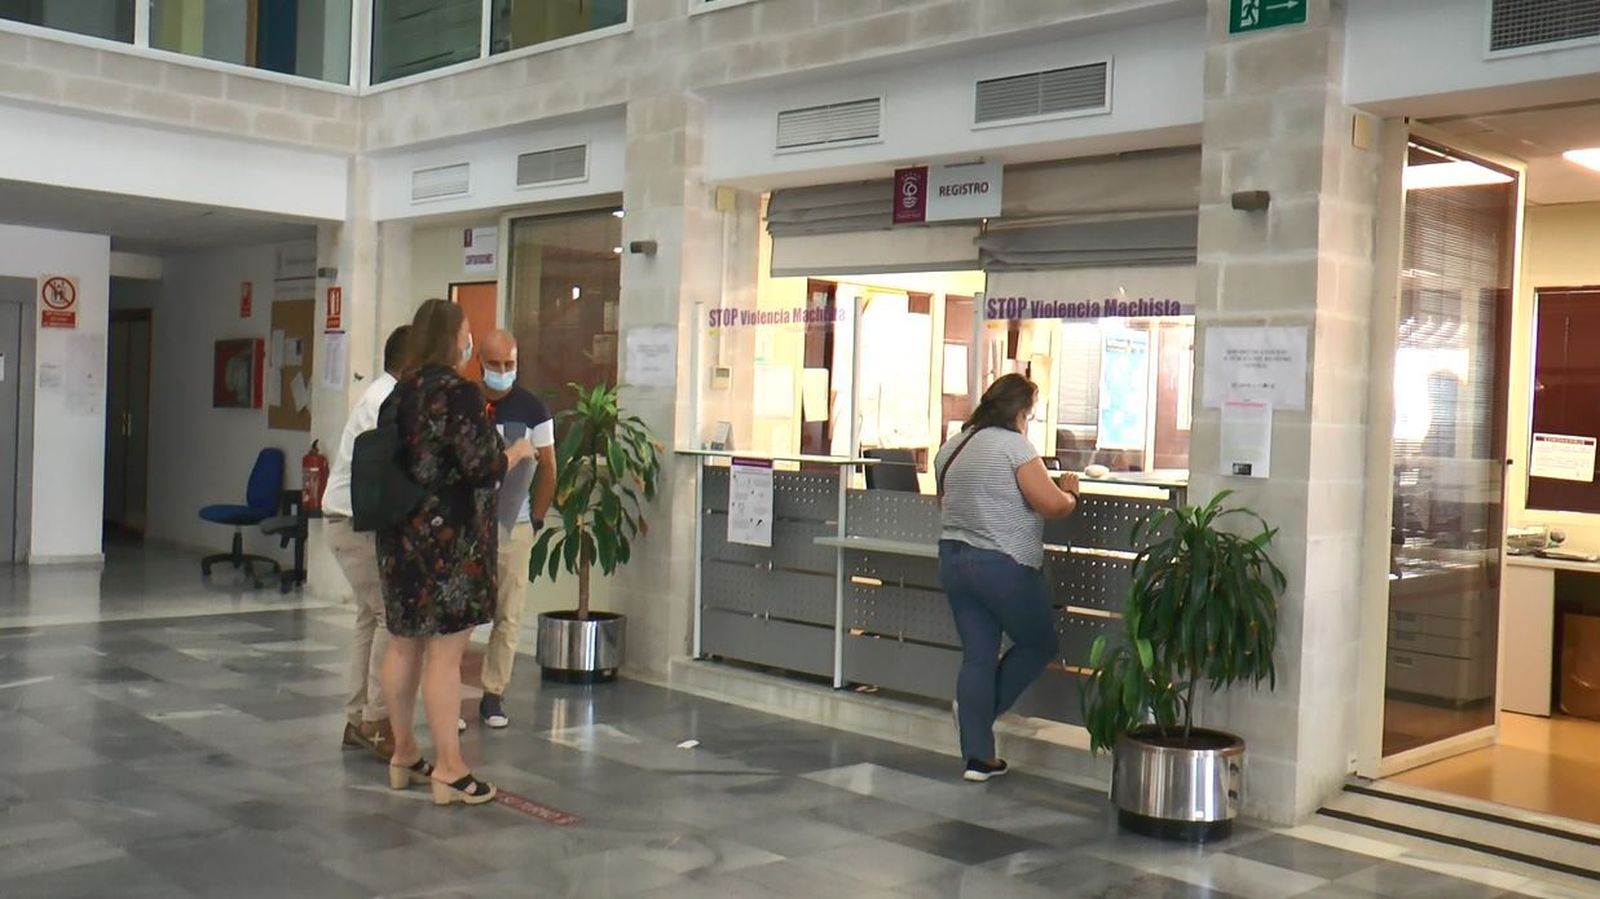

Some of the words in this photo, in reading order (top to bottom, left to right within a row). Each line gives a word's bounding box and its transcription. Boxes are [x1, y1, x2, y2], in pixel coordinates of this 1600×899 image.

[939, 181, 989, 197] REGISTRO
[709, 308, 738, 327] STOP
[741, 308, 789, 325] Violencia
[987, 297, 1027, 319] STOP
[1031, 299, 1099, 318] Violencia
[1104, 298, 1181, 317] Machista
